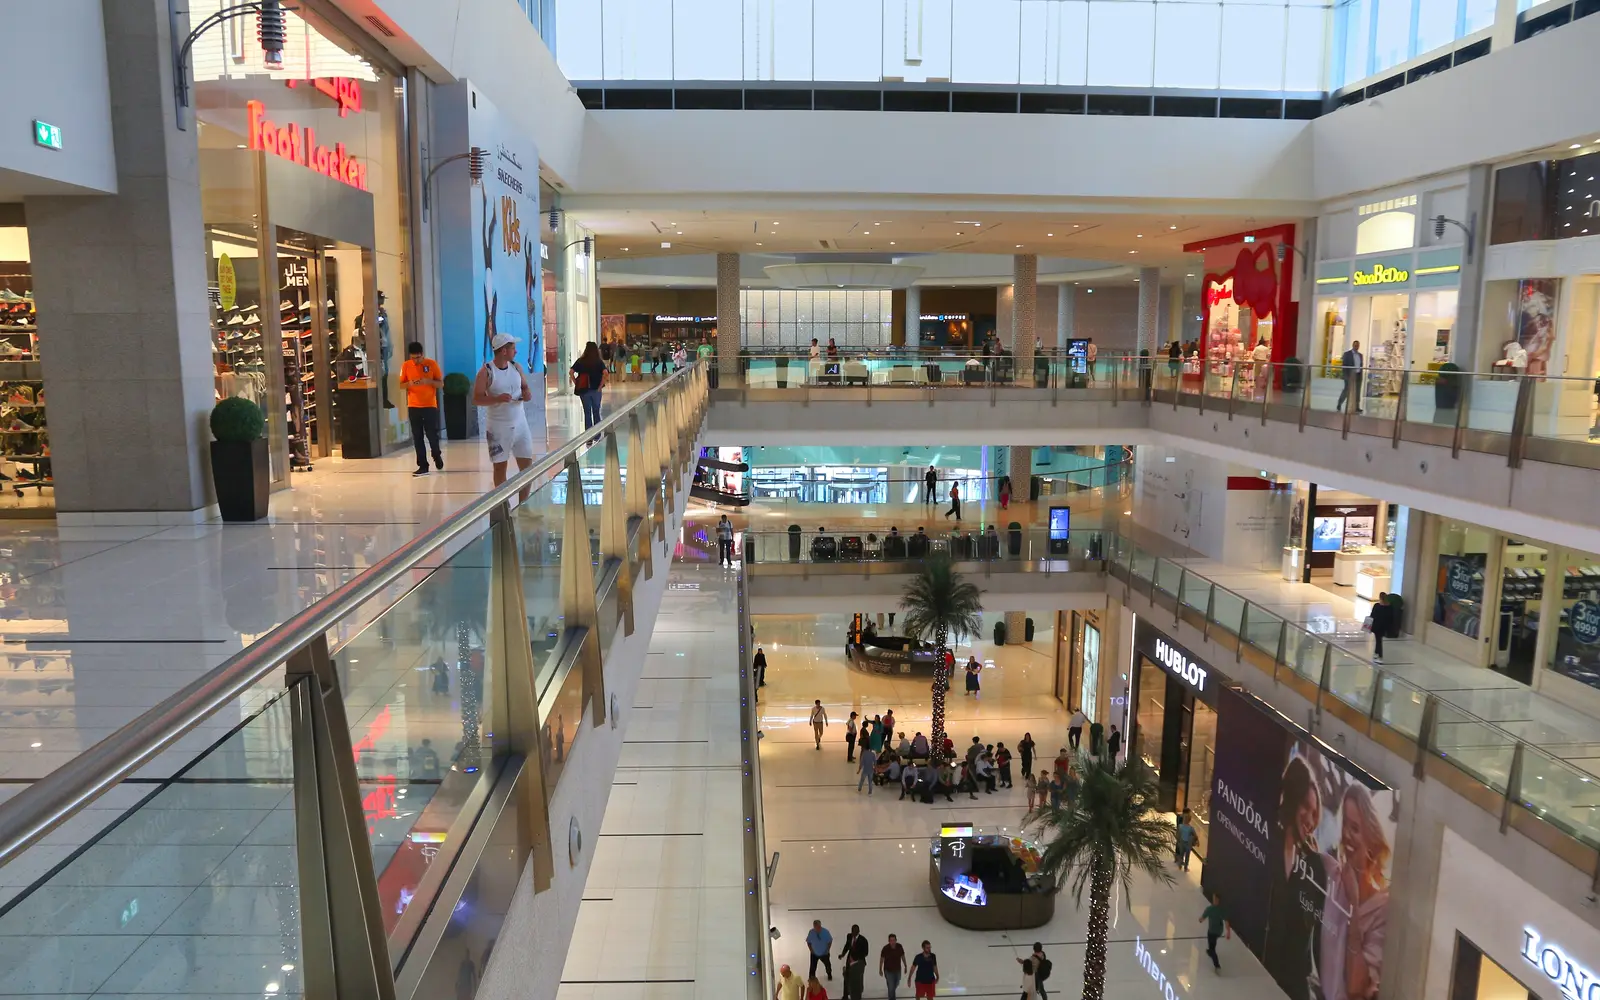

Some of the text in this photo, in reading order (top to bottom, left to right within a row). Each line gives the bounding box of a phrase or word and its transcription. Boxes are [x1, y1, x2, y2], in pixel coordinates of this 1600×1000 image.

[247, 100, 305, 165] Foot
[498, 168, 522, 194] SKECHERS
[501, 194, 520, 257] Kids
[284, 263, 308, 276] جال
[1353, 264, 1409, 286] ShooBeDoo
[1452, 563, 1461, 579] 3
[1576, 601, 1587, 621] 3
[1155, 638, 1207, 692] HUBLOT
[1217, 778, 1269, 840] PANDORA
[1216, 810, 1266, 865] OPENING SOON
